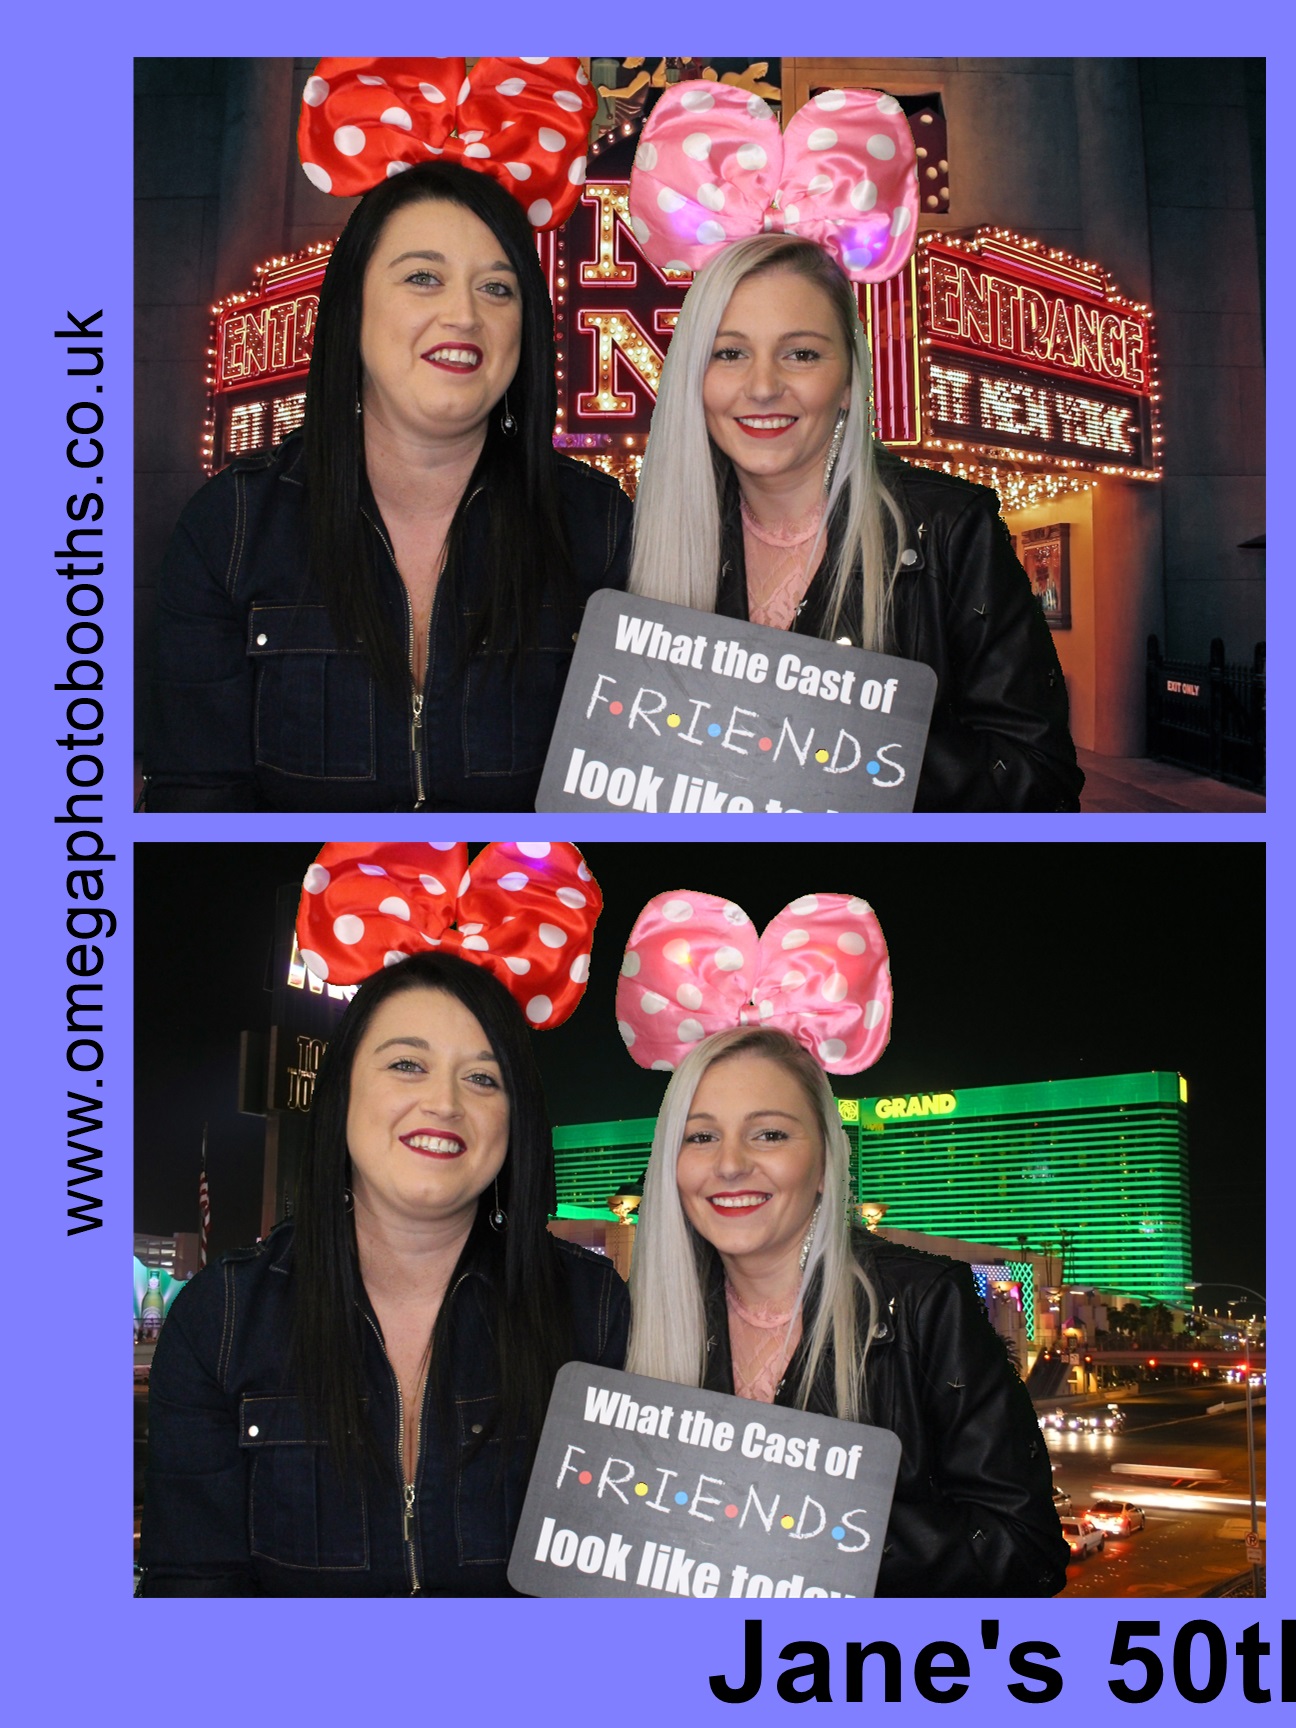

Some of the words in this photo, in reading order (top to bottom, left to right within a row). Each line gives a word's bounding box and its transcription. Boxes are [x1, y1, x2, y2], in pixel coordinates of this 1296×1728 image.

[929, 256, 1145, 384] ENTRANCE
[979, 376, 1053, 442] NEW
[614, 614, 708, 670] What
[711, 641, 769, 684] the
[775, 653, 857, 705] Cast
[859, 678, 899, 714] of
[1167, 680, 1182, 693] EXIT
[1182, 682, 1200, 697] ONLY
[562, 747, 664, 813] look
[297, 1035, 329, 1076] TO
[287, 1070, 316, 1113] JO
[875, 1093, 957, 1120] GRAND
[583, 1386, 674, 1439] What
[677, 1409, 735, 1452] the
[740, 1422, 821, 1473] Cast
[823, 1445, 864, 1480] of
[533, 1516, 634, 1582] look
[635, 1540, 722, 1598] like
[728, 1564, 857, 1598] tod
